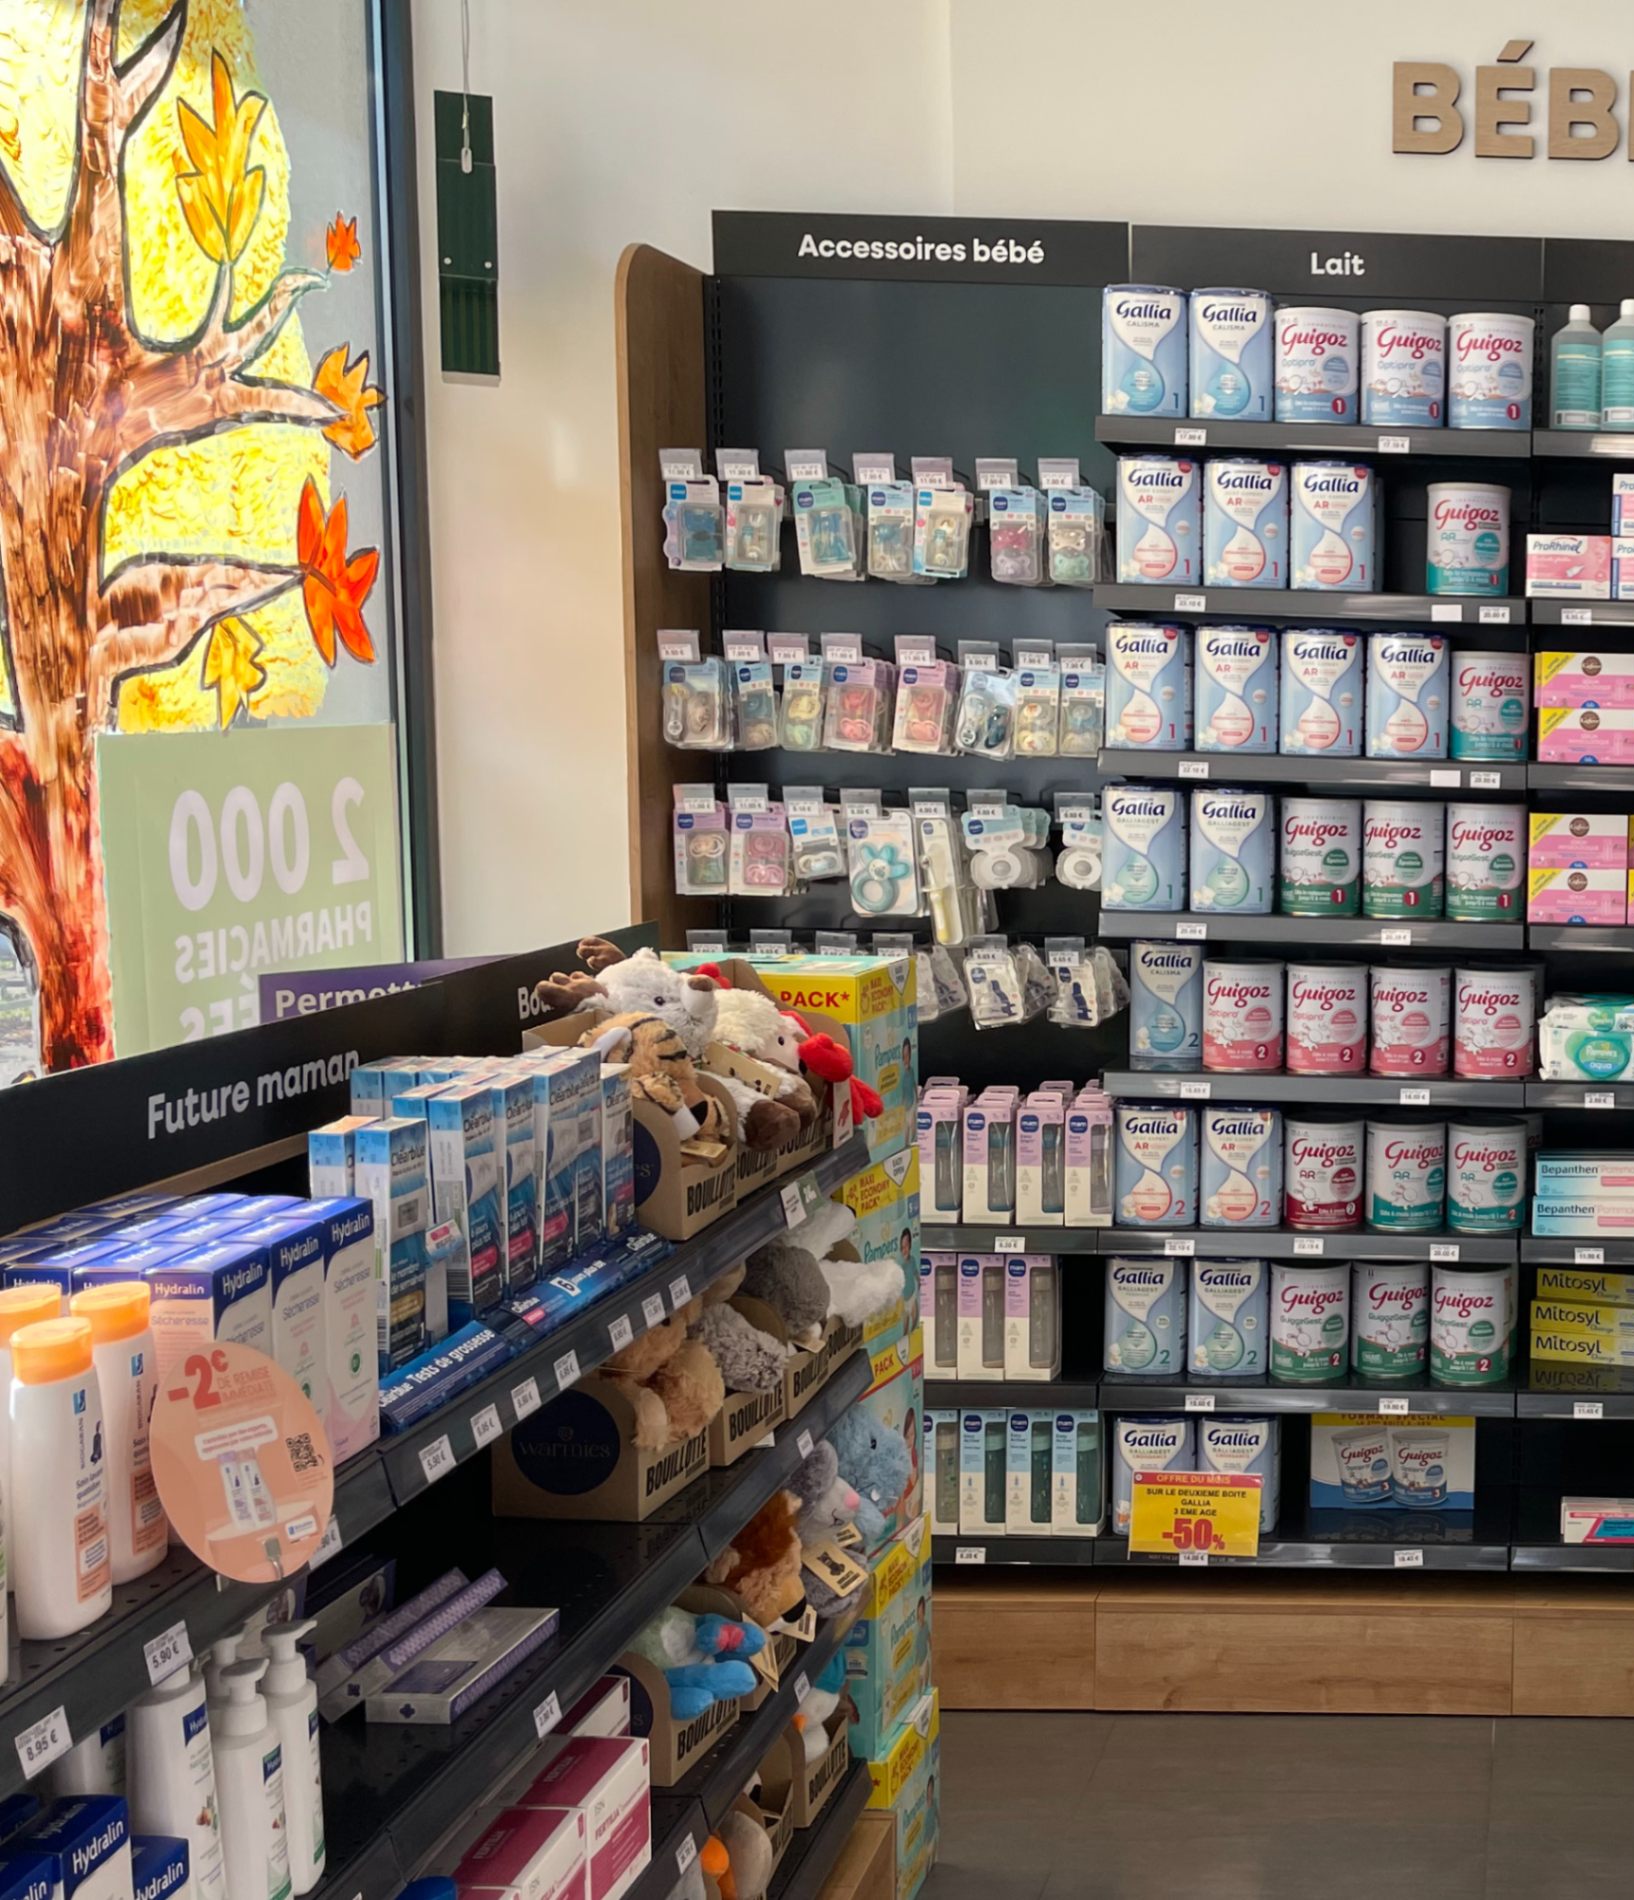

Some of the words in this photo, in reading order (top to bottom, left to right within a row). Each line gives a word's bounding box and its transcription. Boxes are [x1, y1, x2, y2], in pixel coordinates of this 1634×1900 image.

[798, 234, 966, 261] Accessoires
[973, 239, 1044, 263] bébé
[1310, 252, 1365, 276] Lait
[1116, 300, 1171, 320] Gallia
[1202, 302, 1257, 323] Gallia
[1281, 324, 1348, 359] Guigoz
[1377, 327, 1442, 359] Guigoz
[1456, 328, 1523, 362] Guigoz
[1128, 467, 1183, 489] Gallia
[1217, 470, 1272, 491] Gallia
[1303, 471, 1359, 494] Gallia
[1434, 500, 1499, 532] Guigoz
[1116, 635, 1168, 656] Gallia
[1206, 637, 1261, 659] Gallia
[1294, 641, 1348, 663] Gallia
[1380, 644, 1435, 665] Gallia
[1216, 664, 1231, 674] AR
[1303, 667, 1318, 677] AR
[1391, 670, 1406, 679] AR
[1459, 667, 1523, 697] Guigoz
[1112, 798, 1166, 820] Gallia
[1203, 801, 1257, 822] Gallia
[1284, 816, 1349, 848] Guigoz
[1364, 818, 1422, 849] Guigoz
[1451, 820, 1515, 851] Guigoz
[1141, 952, 1192, 971] Gallia
[1208, 977, 1270, 1007] Guigoz
[1292, 979, 1356, 1009] Guigoz
[1373, 981, 1428, 1012] Guigoz
[1459, 983, 1520, 1015] Guigoz
[1188, 1032, 1199, 1048] 2
[147, 1079, 251, 1140] Future
[257, 1050, 359, 1107] maman
[1125, 1115, 1178, 1136] Gallia
[1211, 1117, 1264, 1137] Gallia
[1134, 1141, 1150, 1151] AR
[1221, 1141, 1236, 1151] AR
[1292, 1137, 1357, 1169] Guigoz
[1385, 1140, 1444, 1170] Guigoz
[1455, 1141, 1516, 1171] Guigoz
[1541, 1163, 1598, 1176] Bepanthen
[1537, 1203, 1595, 1215] Bepanthen
[331, 1214, 370, 1243] Hydralin
[280, 1236, 319, 1268] Hydralin
[222, 1263, 263, 1295] Hydralin
[1113, 1267, 1165, 1287] Gallia
[1199, 1268, 1252, 1289] Gallia
[1541, 1273, 1607, 1293] Mitosyl
[155, 1282, 204, 1296] Hydralin
[1280, 1285, 1345, 1315] Guigoz
[1369, 1282, 1428, 1314] Guigoz
[1434, 1287, 1494, 1317] Guigoz
[1535, 1306, 1601, 1327] Mitosyl
[1536, 1335, 1602, 1355] Mitosyl
[1246, 1350, 1257, 1365] 2
[1123, 1428, 1176, 1449] Gallia
[1208, 1429, 1260, 1449] Gallia
[1341, 1445, 1384, 1464] Guigoz
[1398, 1448, 1442, 1466] Guigoz
[1156, 1475, 1188, 1483] OFFRE
[1191, 1475, 1203, 1483] DU
[1178, 1489, 1220, 1497] DEUXIEME
[1222, 1490, 1247, 1498] BOITE
[1162, 1518, 1225, 1550] -50%
[152, 1647, 171, 1670] 5.90
[172, 1643, 180, 1656] €
[26, 1736, 49, 1762] 8.95
[50, 1729, 58, 1744] €
[72, 1819, 124, 1875] Hydralin
